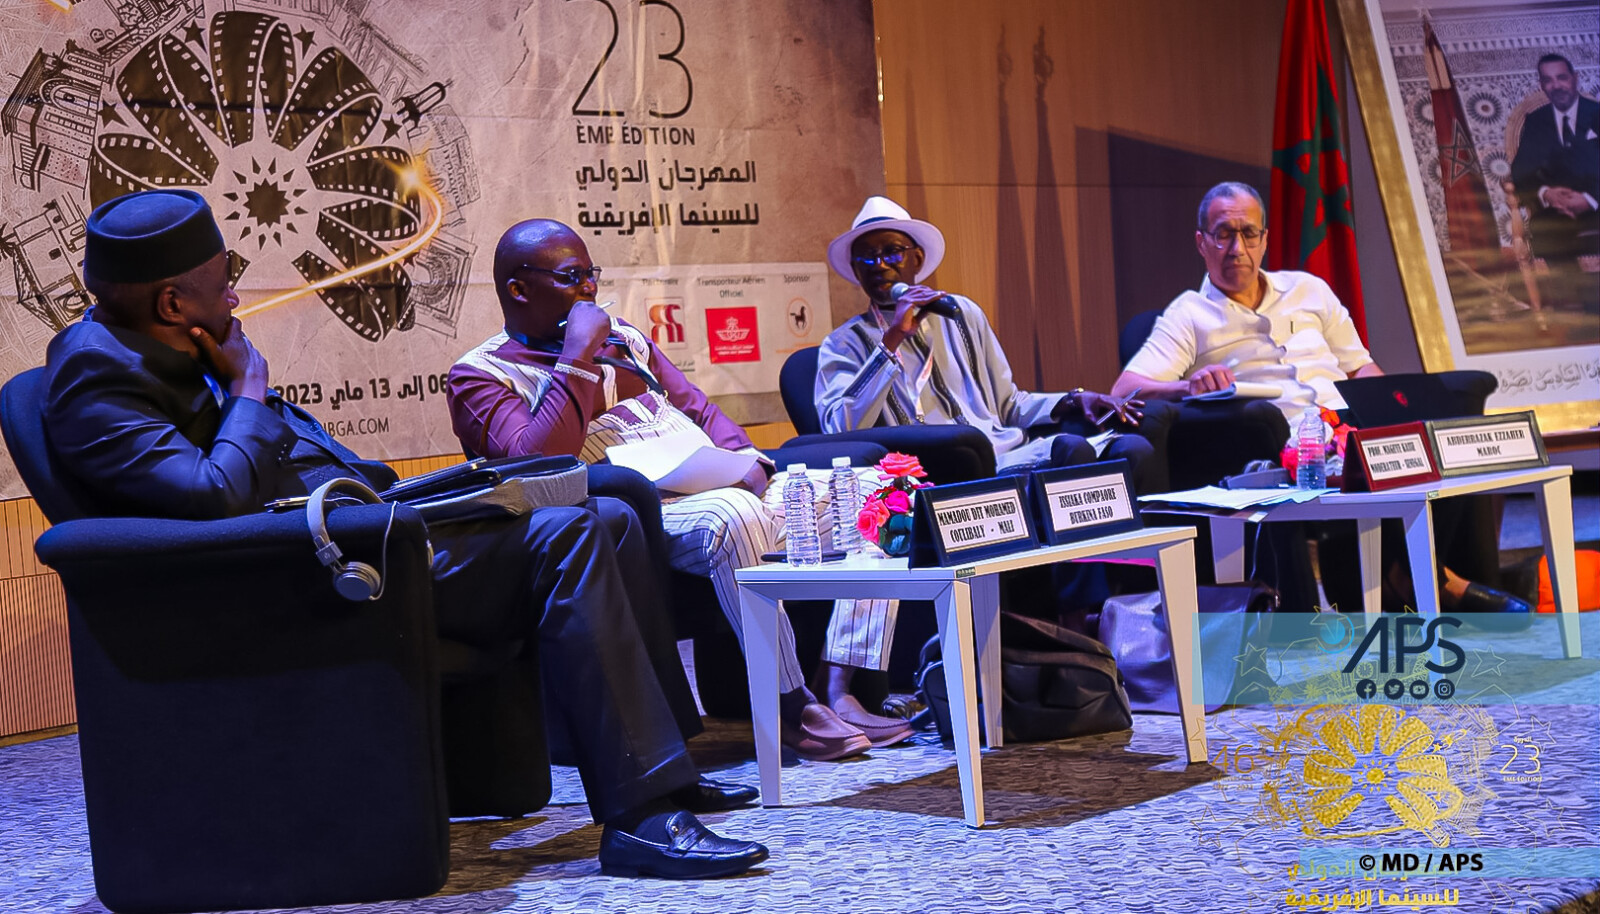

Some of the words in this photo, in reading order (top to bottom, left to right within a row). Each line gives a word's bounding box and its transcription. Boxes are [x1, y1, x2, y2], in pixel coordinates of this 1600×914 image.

[572, 0, 693, 119] 23
[575, 119, 615, 145] ÈME
[621, 120, 696, 146] ÉDITION
[575, 158, 649, 191] الدولي
[658, 158, 757, 191] المهرجان
[679, 201, 759, 234] للسينما
[783, 273, 810, 285] Sponsor
[329, 380, 364, 411] ماي
[368, 377, 391, 400] 13
[396, 374, 425, 401] إلى
[323, 416, 390, 437] IBGA.COM
[1446, 431, 1495, 447] ABDERRAZAK
[1493, 428, 1526, 443] EZZAHER
[1476, 445, 1503, 457] MAROC
[1058, 492, 1084, 509] ISSIAKA
[1082, 487, 1117, 505] COMPAORE
[937, 507, 972, 527] MAMADOU
[970, 505, 986, 522] DIT
[984, 501, 1017, 519] MOHAMED
[1069, 507, 1099, 525] BURKINA
[1096, 505, 1114, 521] FASO
[949, 524, 986, 543] COULIBALY
[998, 518, 1016, 535] MALI
